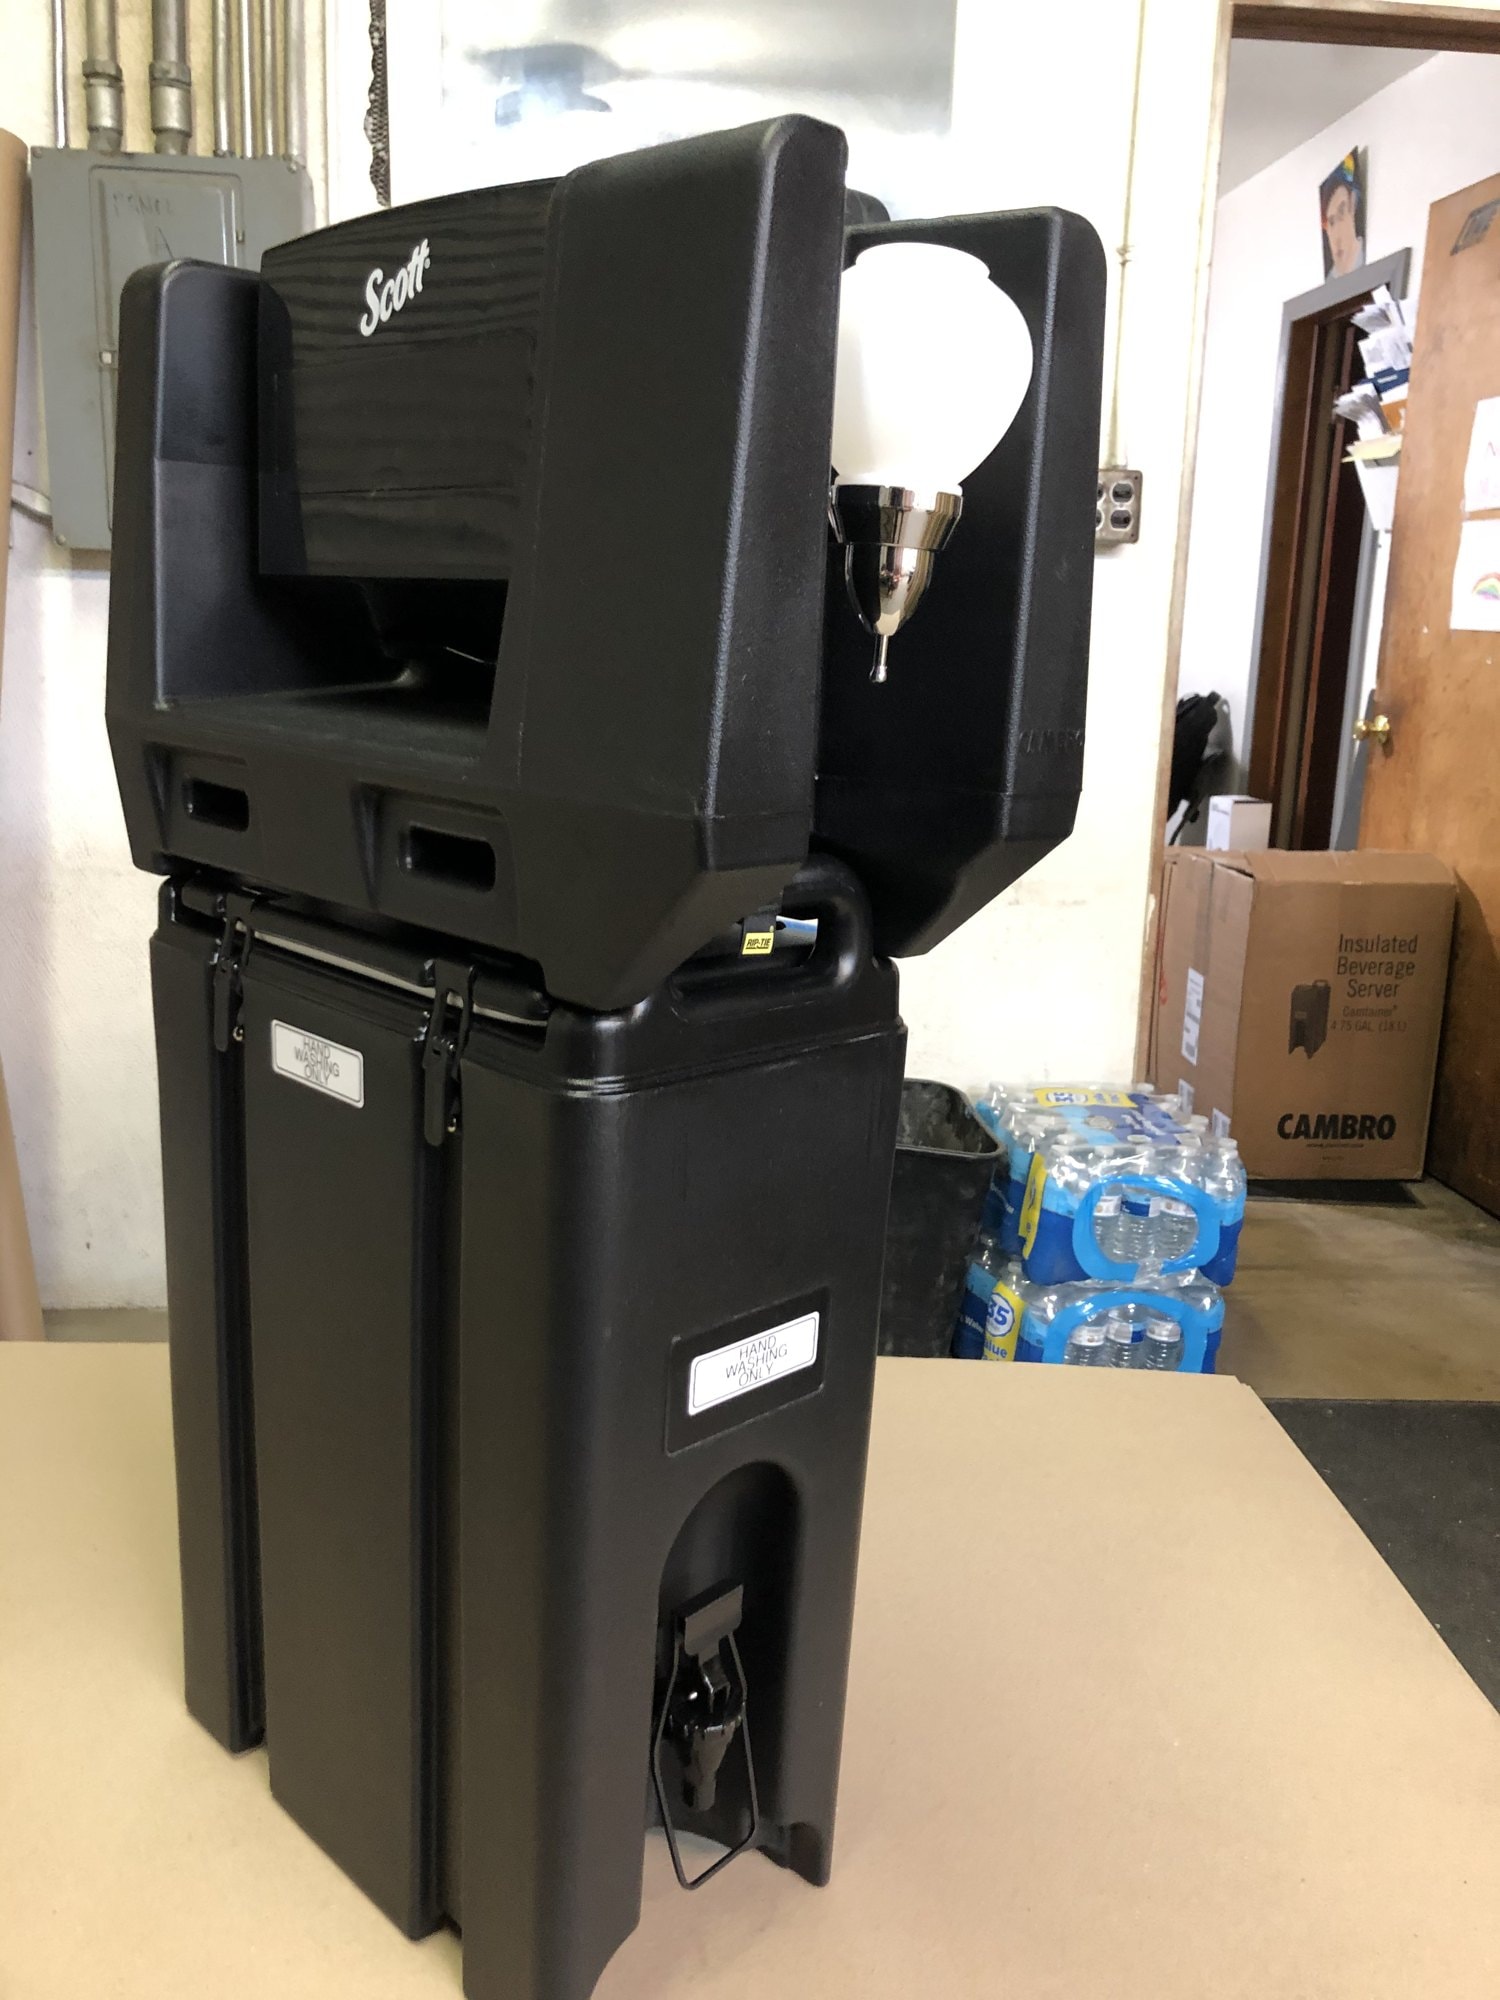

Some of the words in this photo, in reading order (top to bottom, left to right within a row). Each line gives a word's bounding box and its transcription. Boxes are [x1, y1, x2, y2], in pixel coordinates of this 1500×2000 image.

[360, 238, 430, 337] Scott
[1338, 933, 1418, 954] Insulated
[1337, 956, 1416, 980] Beverage
[1347, 978, 1400, 998] Server
[303, 1036, 331, 1060] HAND
[294, 1045, 340, 1078] WASHING
[304, 1064, 331, 1086] ONLY
[1276, 1113, 1397, 1141] CAMBRO
[739, 1335, 777, 1360] HAND
[726, 1344, 788, 1379] WASHING
[738, 1362, 774, 1387] ONLY
